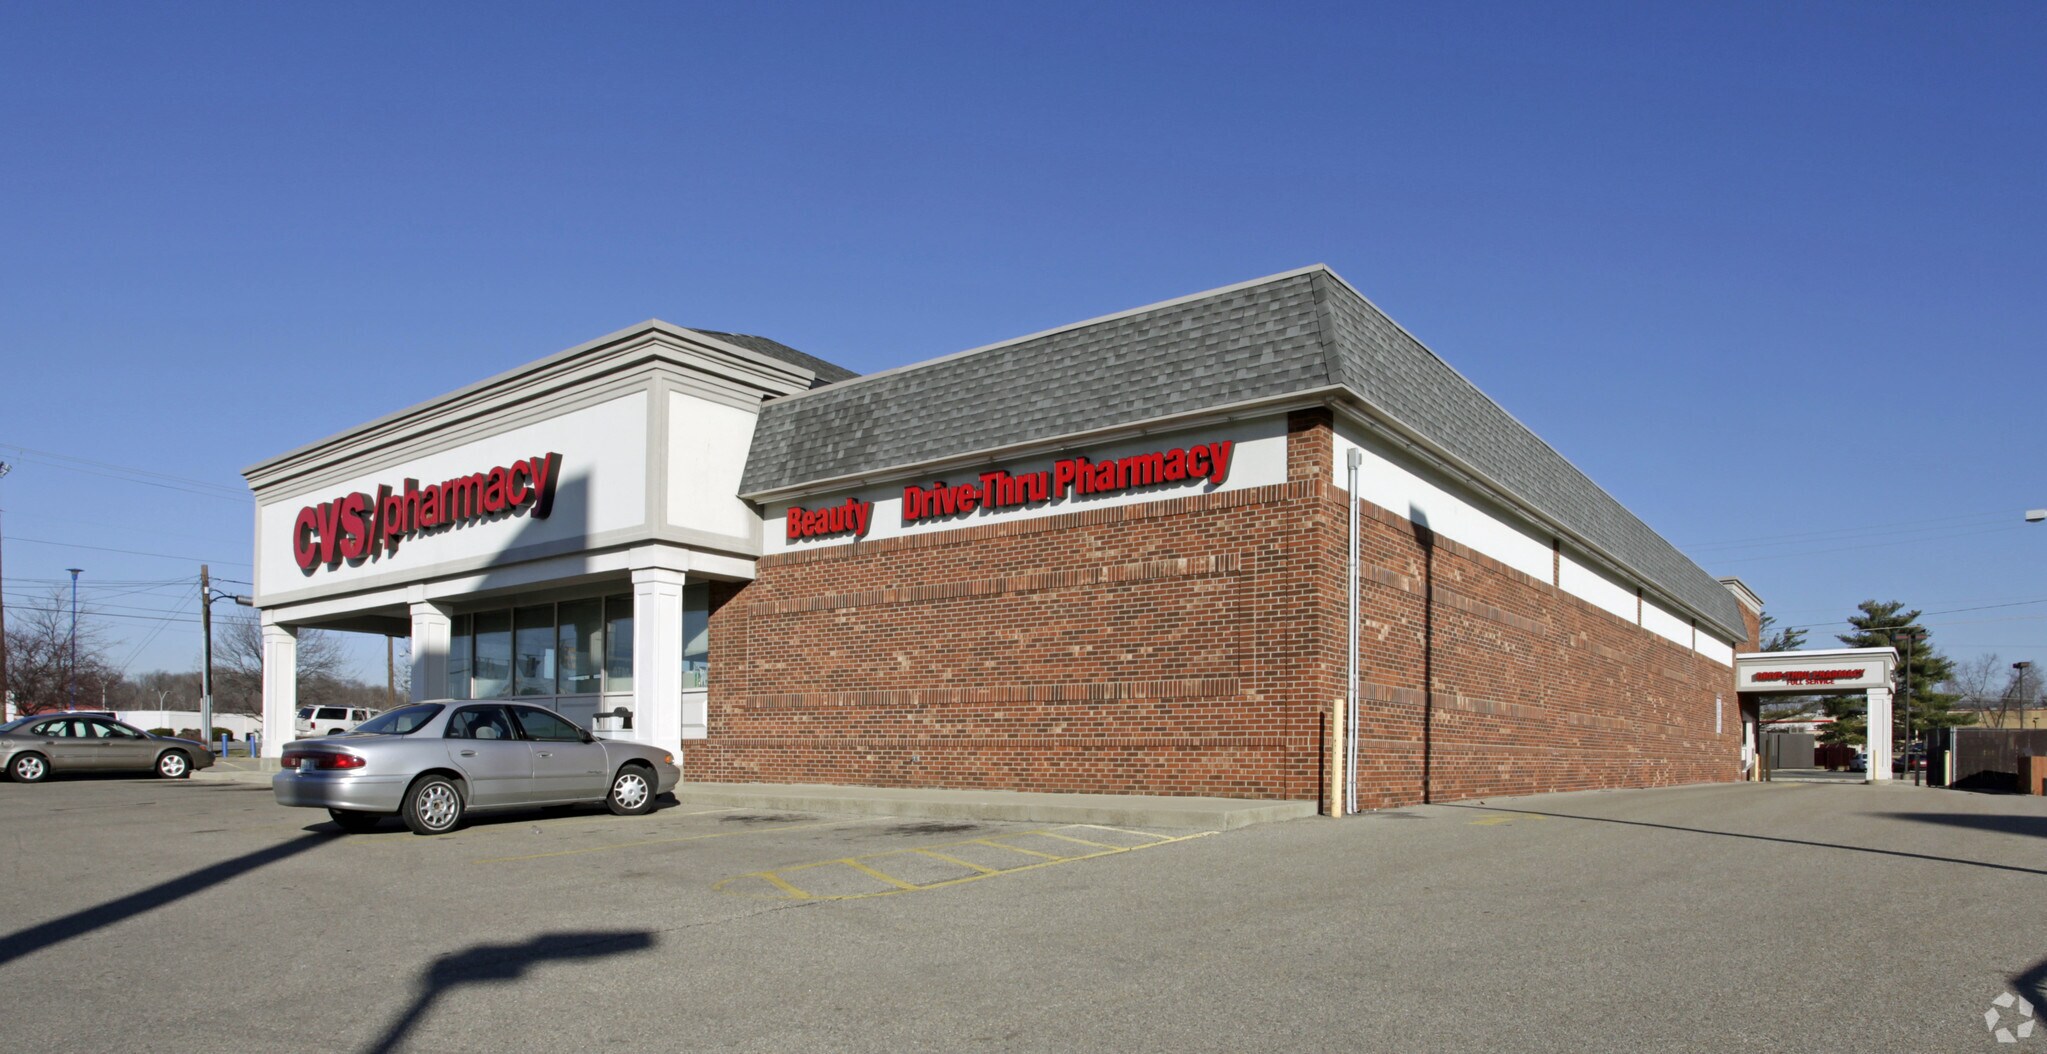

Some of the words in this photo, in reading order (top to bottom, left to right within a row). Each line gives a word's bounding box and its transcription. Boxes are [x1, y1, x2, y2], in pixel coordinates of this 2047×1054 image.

[904, 469, 1050, 520] Drive-Thru
[1054, 440, 1234, 497] Pharmacy
[293, 451, 562, 570] CVS/pharmacy
[786, 498, 871, 539] Beauty
[1812, 669, 1865, 679] PHARMACY
